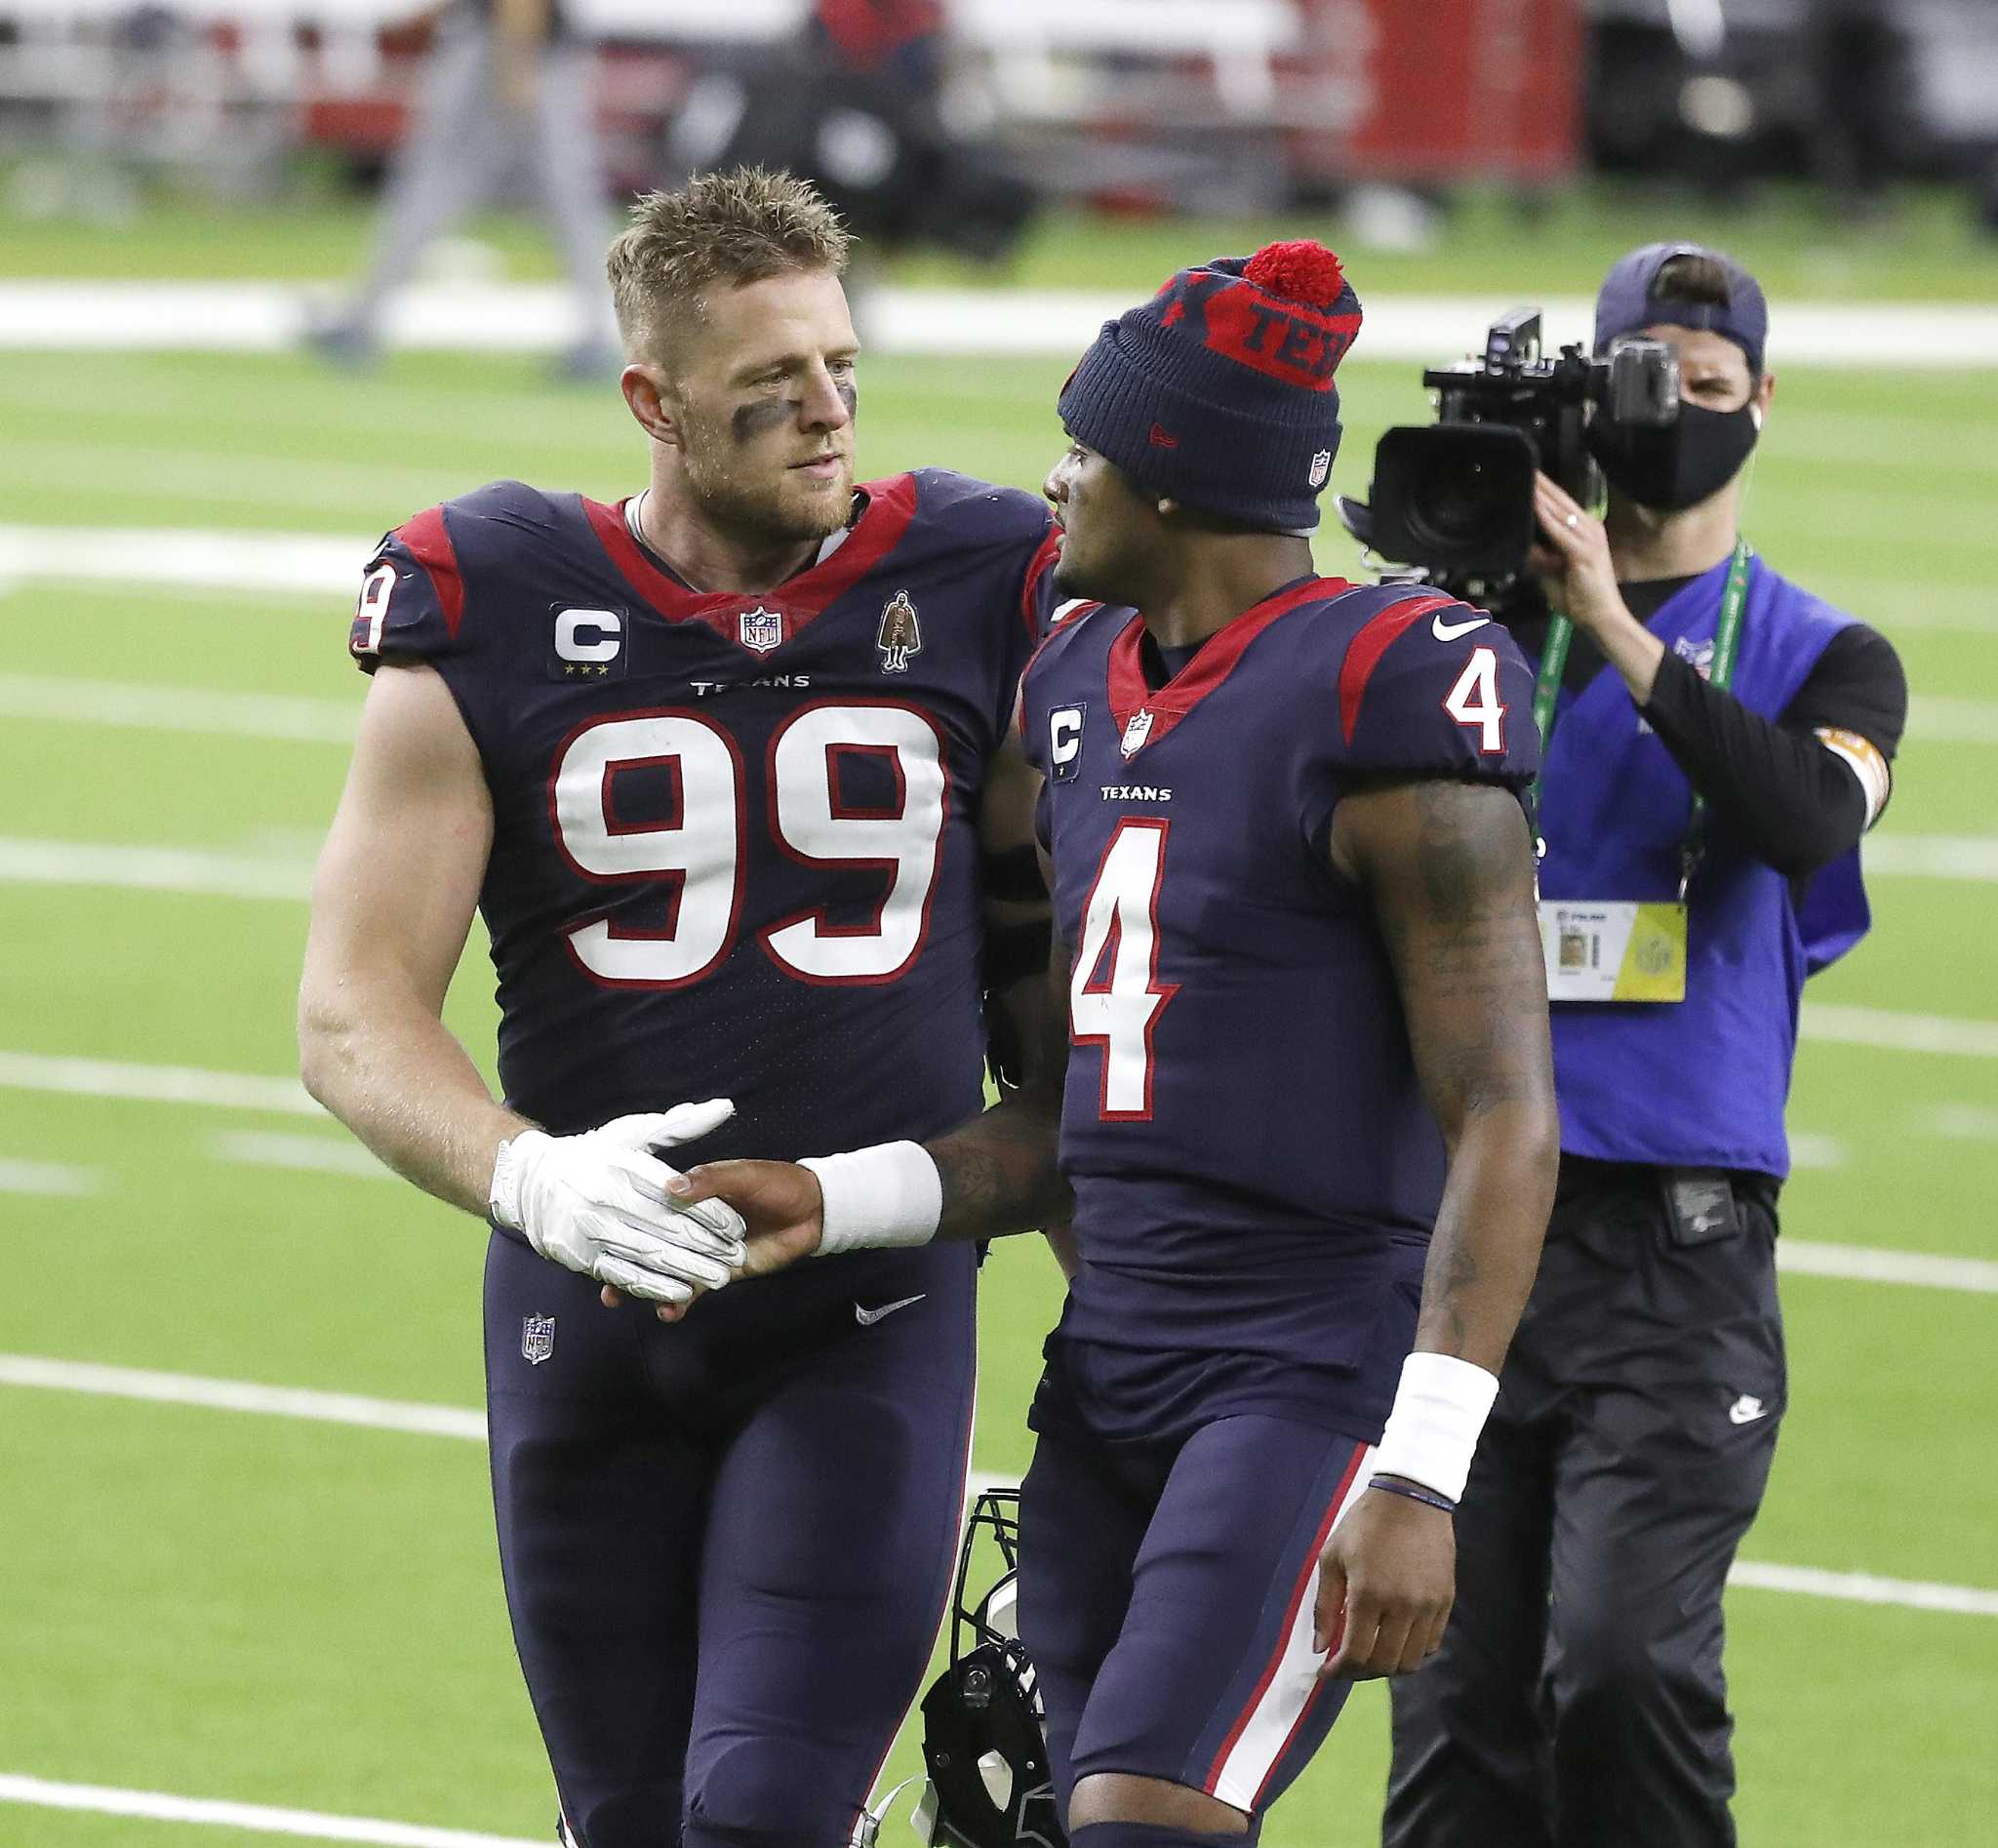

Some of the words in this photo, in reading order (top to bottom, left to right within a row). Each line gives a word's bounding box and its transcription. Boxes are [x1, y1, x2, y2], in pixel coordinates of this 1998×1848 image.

[554, 608, 622, 663] C
[747, 627, 775, 642] NFL
[1442, 646, 1508, 755] 4
[1050, 709, 1083, 765] C
[1100, 785, 1172, 802] TEXANS
[549, 698, 951, 990] 99
[1070, 818, 1180, 1121] 4
